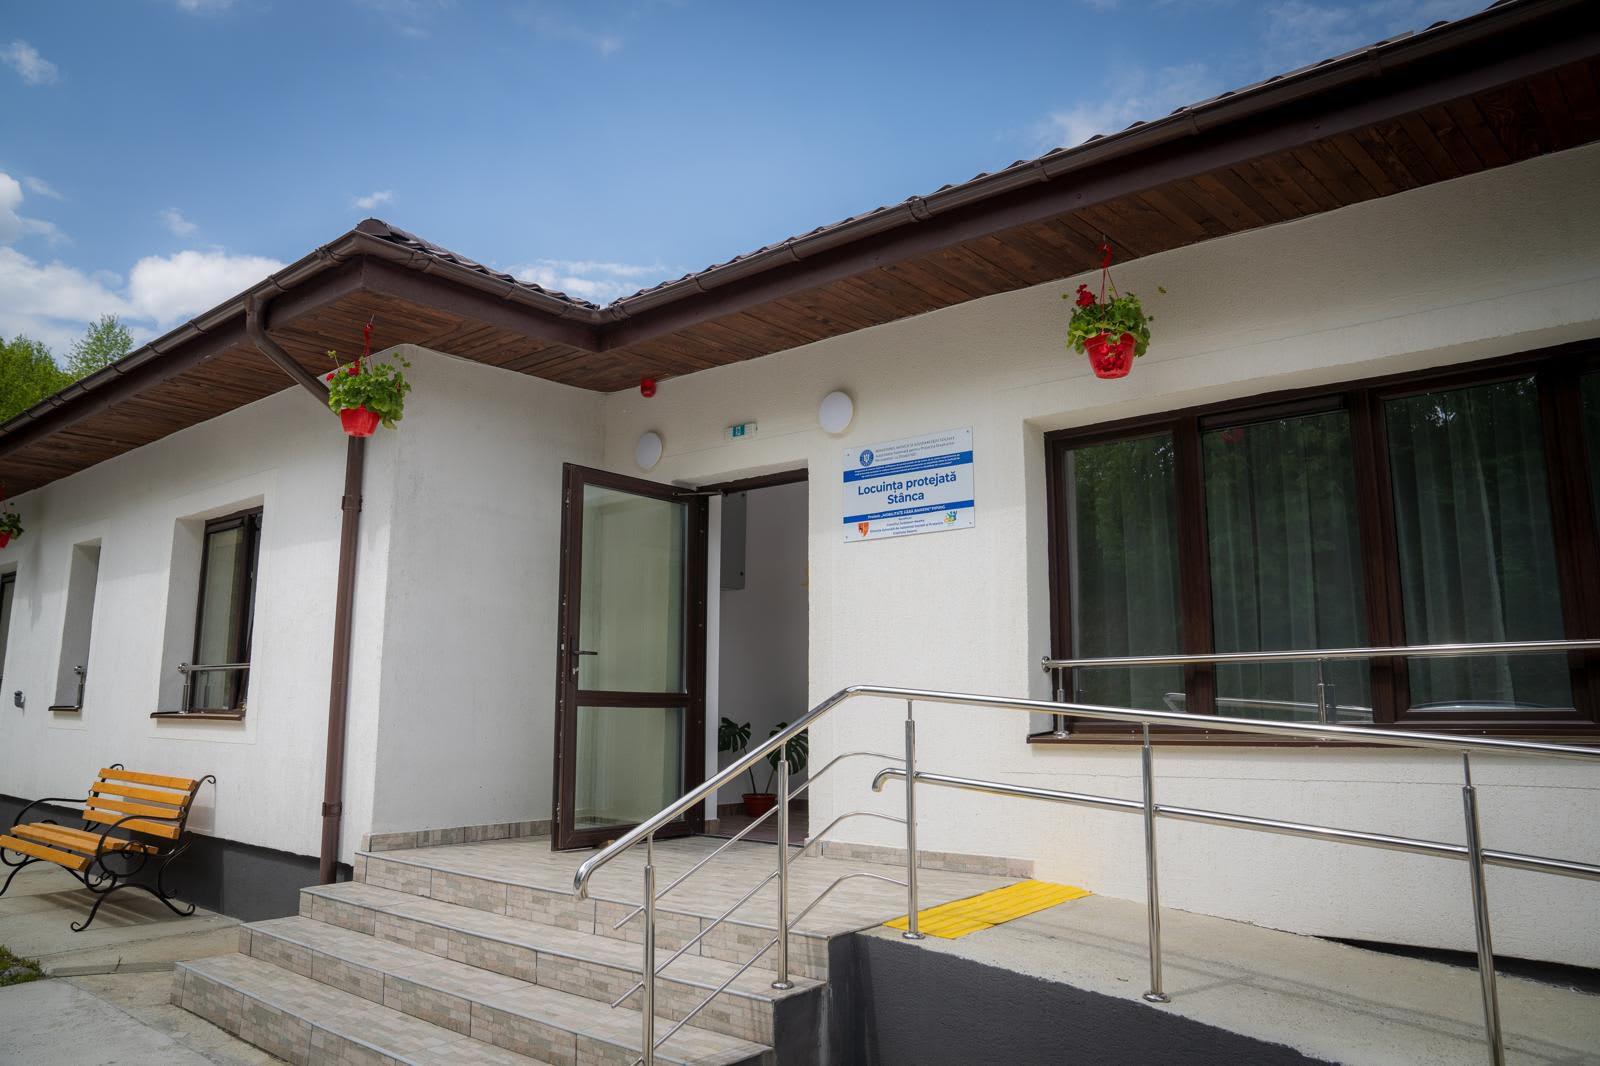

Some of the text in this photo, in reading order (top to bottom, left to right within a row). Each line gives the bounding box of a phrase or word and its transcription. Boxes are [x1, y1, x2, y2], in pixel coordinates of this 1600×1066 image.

[858, 471, 956, 495] Locuința protejată
[887, 491, 925, 505] Stânca
